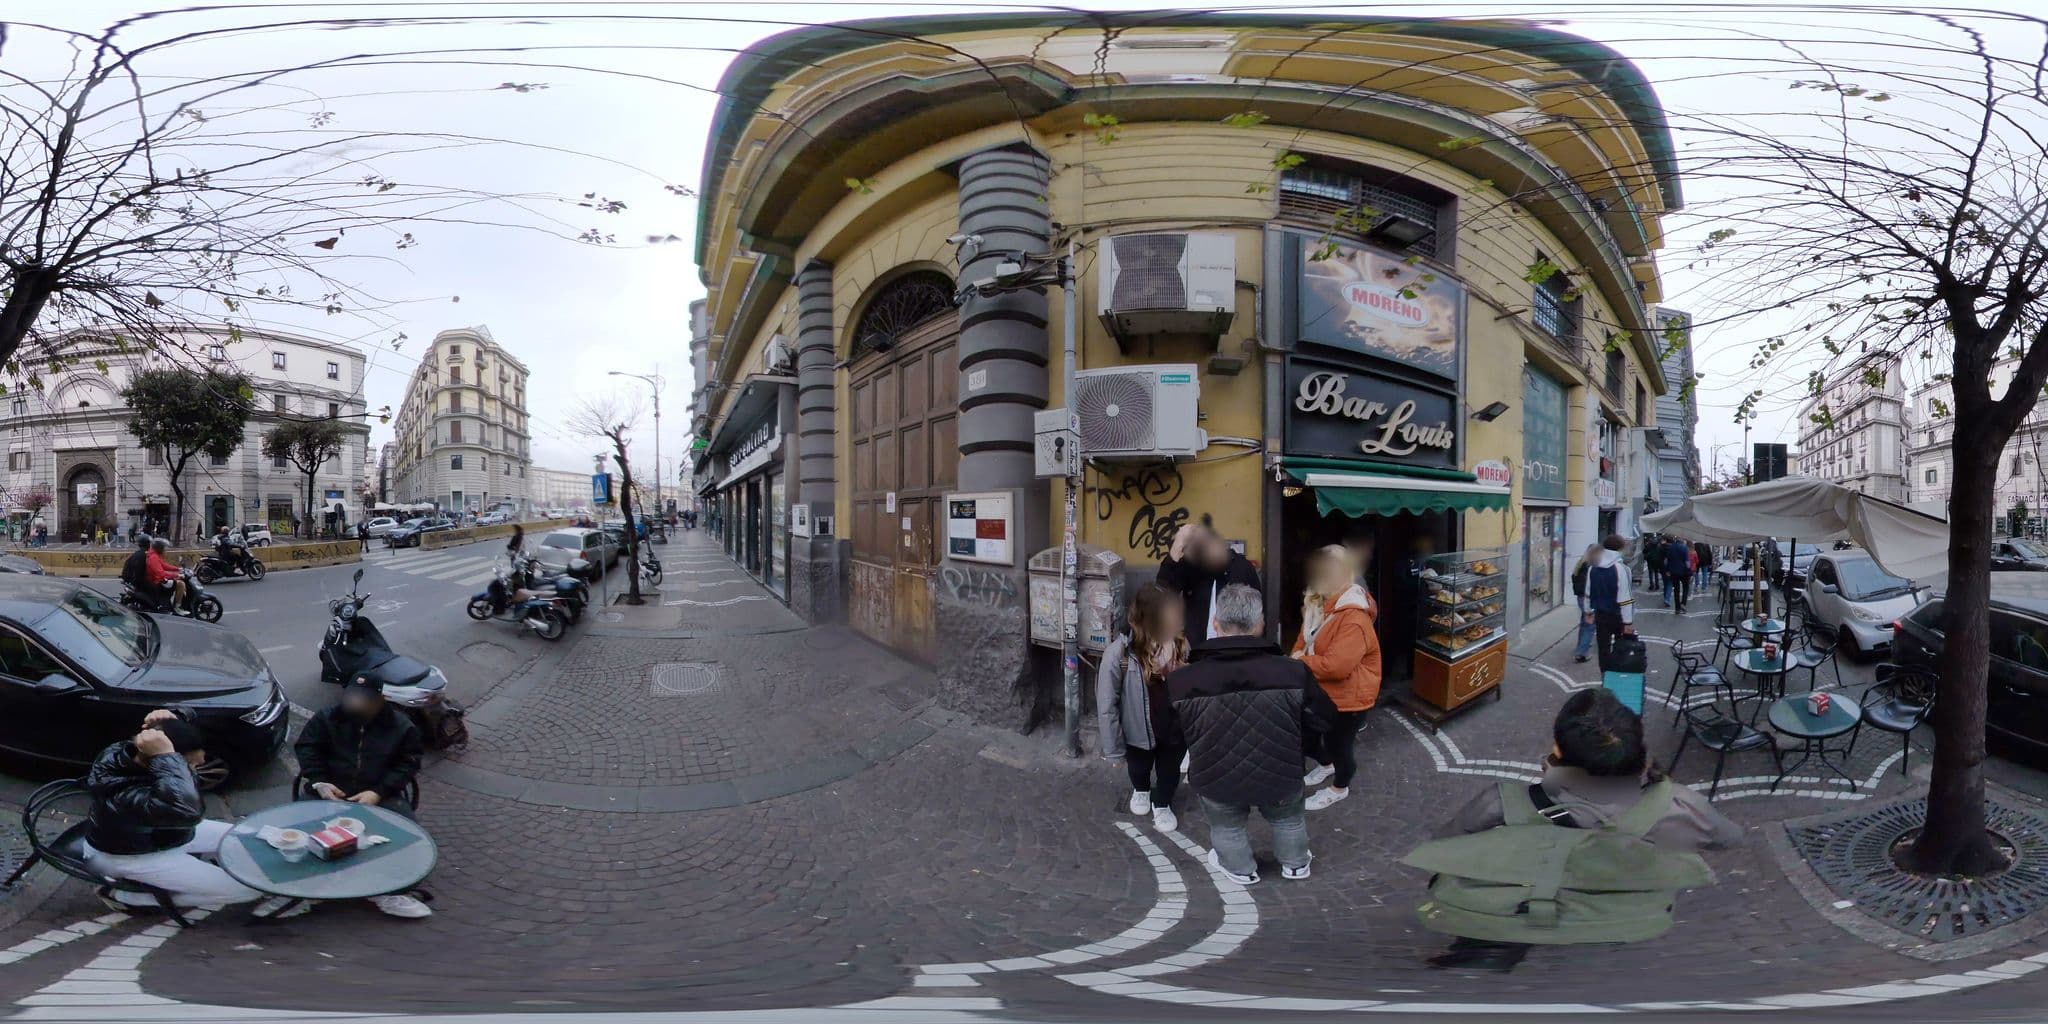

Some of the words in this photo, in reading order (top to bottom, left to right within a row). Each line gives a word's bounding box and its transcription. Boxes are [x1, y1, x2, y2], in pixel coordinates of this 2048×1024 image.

[1352, 287, 1421, 321] MORENO
[1296, 371, 1388, 420] Bar
[1361, 400, 1454, 456] Louis
[1477, 466, 1509, 481] MORENO
